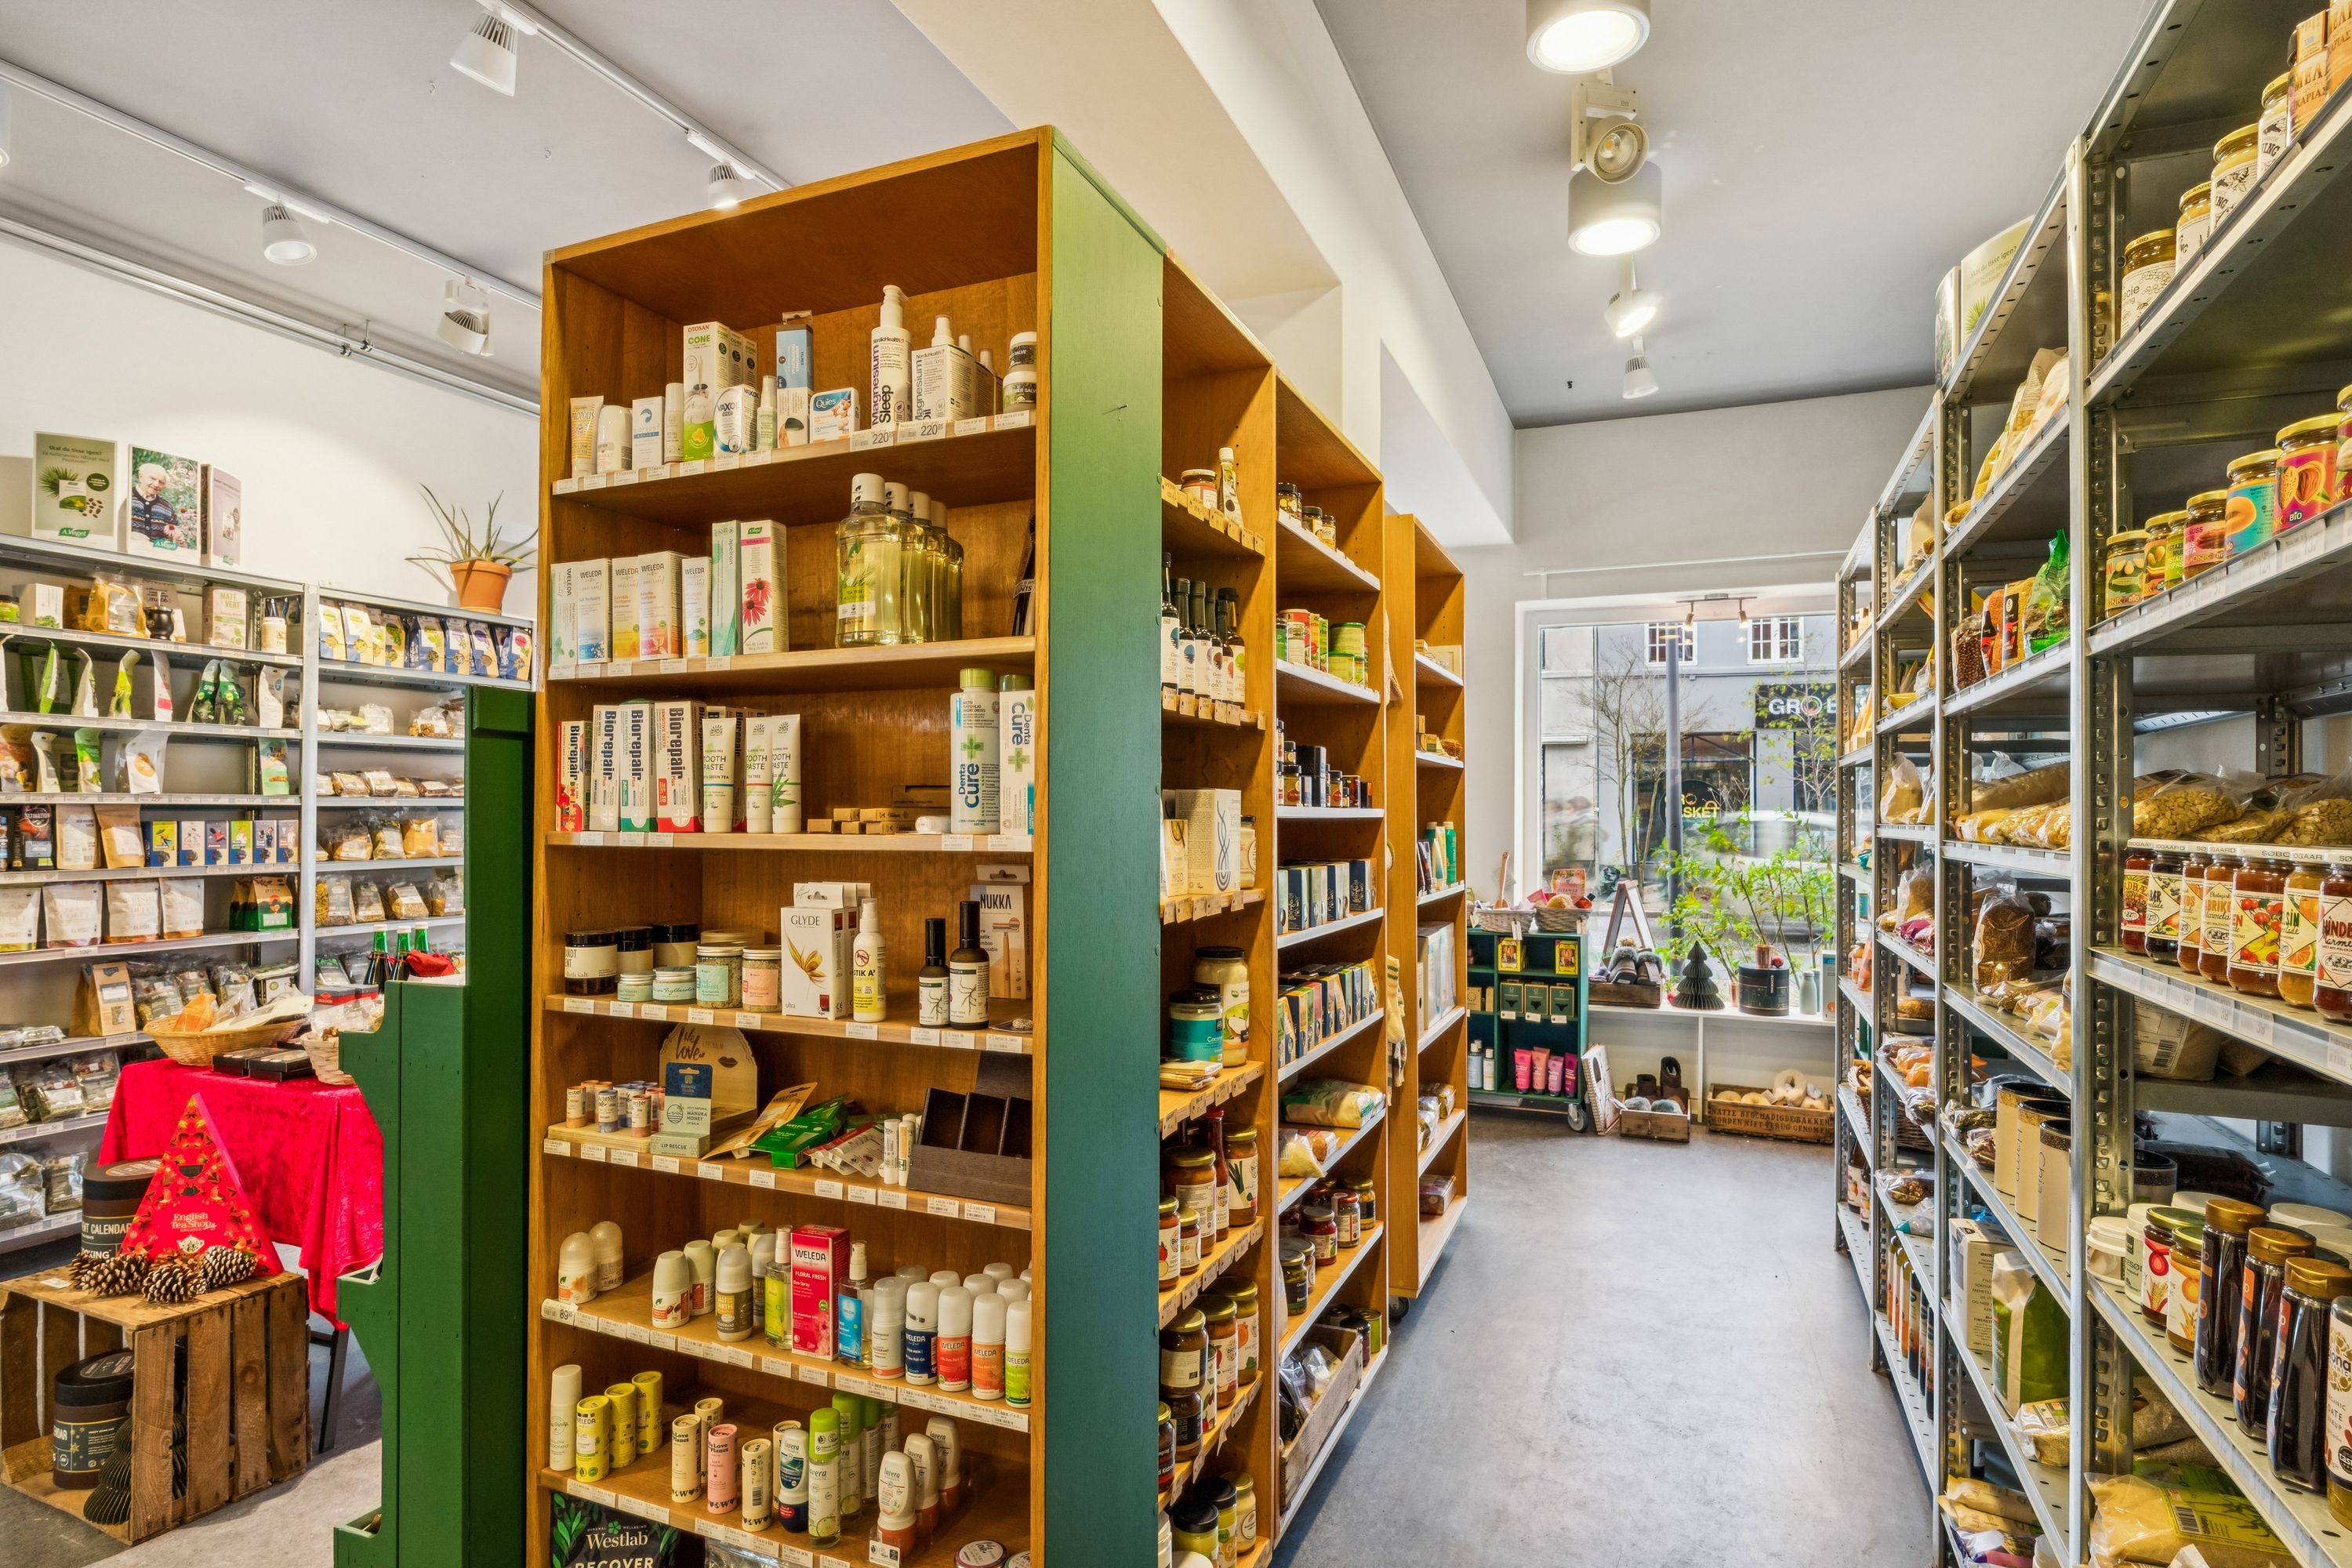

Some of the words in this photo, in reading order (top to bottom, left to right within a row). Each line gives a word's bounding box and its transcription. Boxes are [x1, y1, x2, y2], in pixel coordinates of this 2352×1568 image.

[688, 334, 711, 345] CONE
[815, 398, 837, 408] Quies
[879, 384, 893, 423] Sleep
[921, 424, 938, 436] 220
[873, 433, 889, 445] 220
[2188, 527, 2203, 535] NUSS
[615, 568, 639, 576] WELEDA
[641, 563, 665, 572] WELEDA
[580, 570, 602, 579] WELEDA
[601, 711, 617, 780] Biorepair
[630, 710, 644, 781] Biorepair
[667, 708, 685, 779] Biorepair
[568, 725, 580, 781] Biorepair
[1171, 872, 1184, 883] MISO
[980, 895, 1011, 909] NUKKA
[790, 914, 820, 927] GLYDE
[1796, 1116, 1830, 1126] BAKKEN
[173, 1212, 208, 1222] English
[171, 1221, 187, 1229] Tea
[188, 1220, 212, 1229] Shop
[795, 1248, 826, 1261] WELEDA
[812, 1272, 826, 1281] FRESH
[559, 1310, 568, 1320] 89
[930, 1430, 946, 1440] lavera
[784, 1440, 800, 1450] lavera
[907, 1448, 923, 1459] lavera
[884, 1467, 901, 1479] lavera
[586, 1530, 648, 1550] Westlab
[574, 1556, 655, 1568] RECOVER
